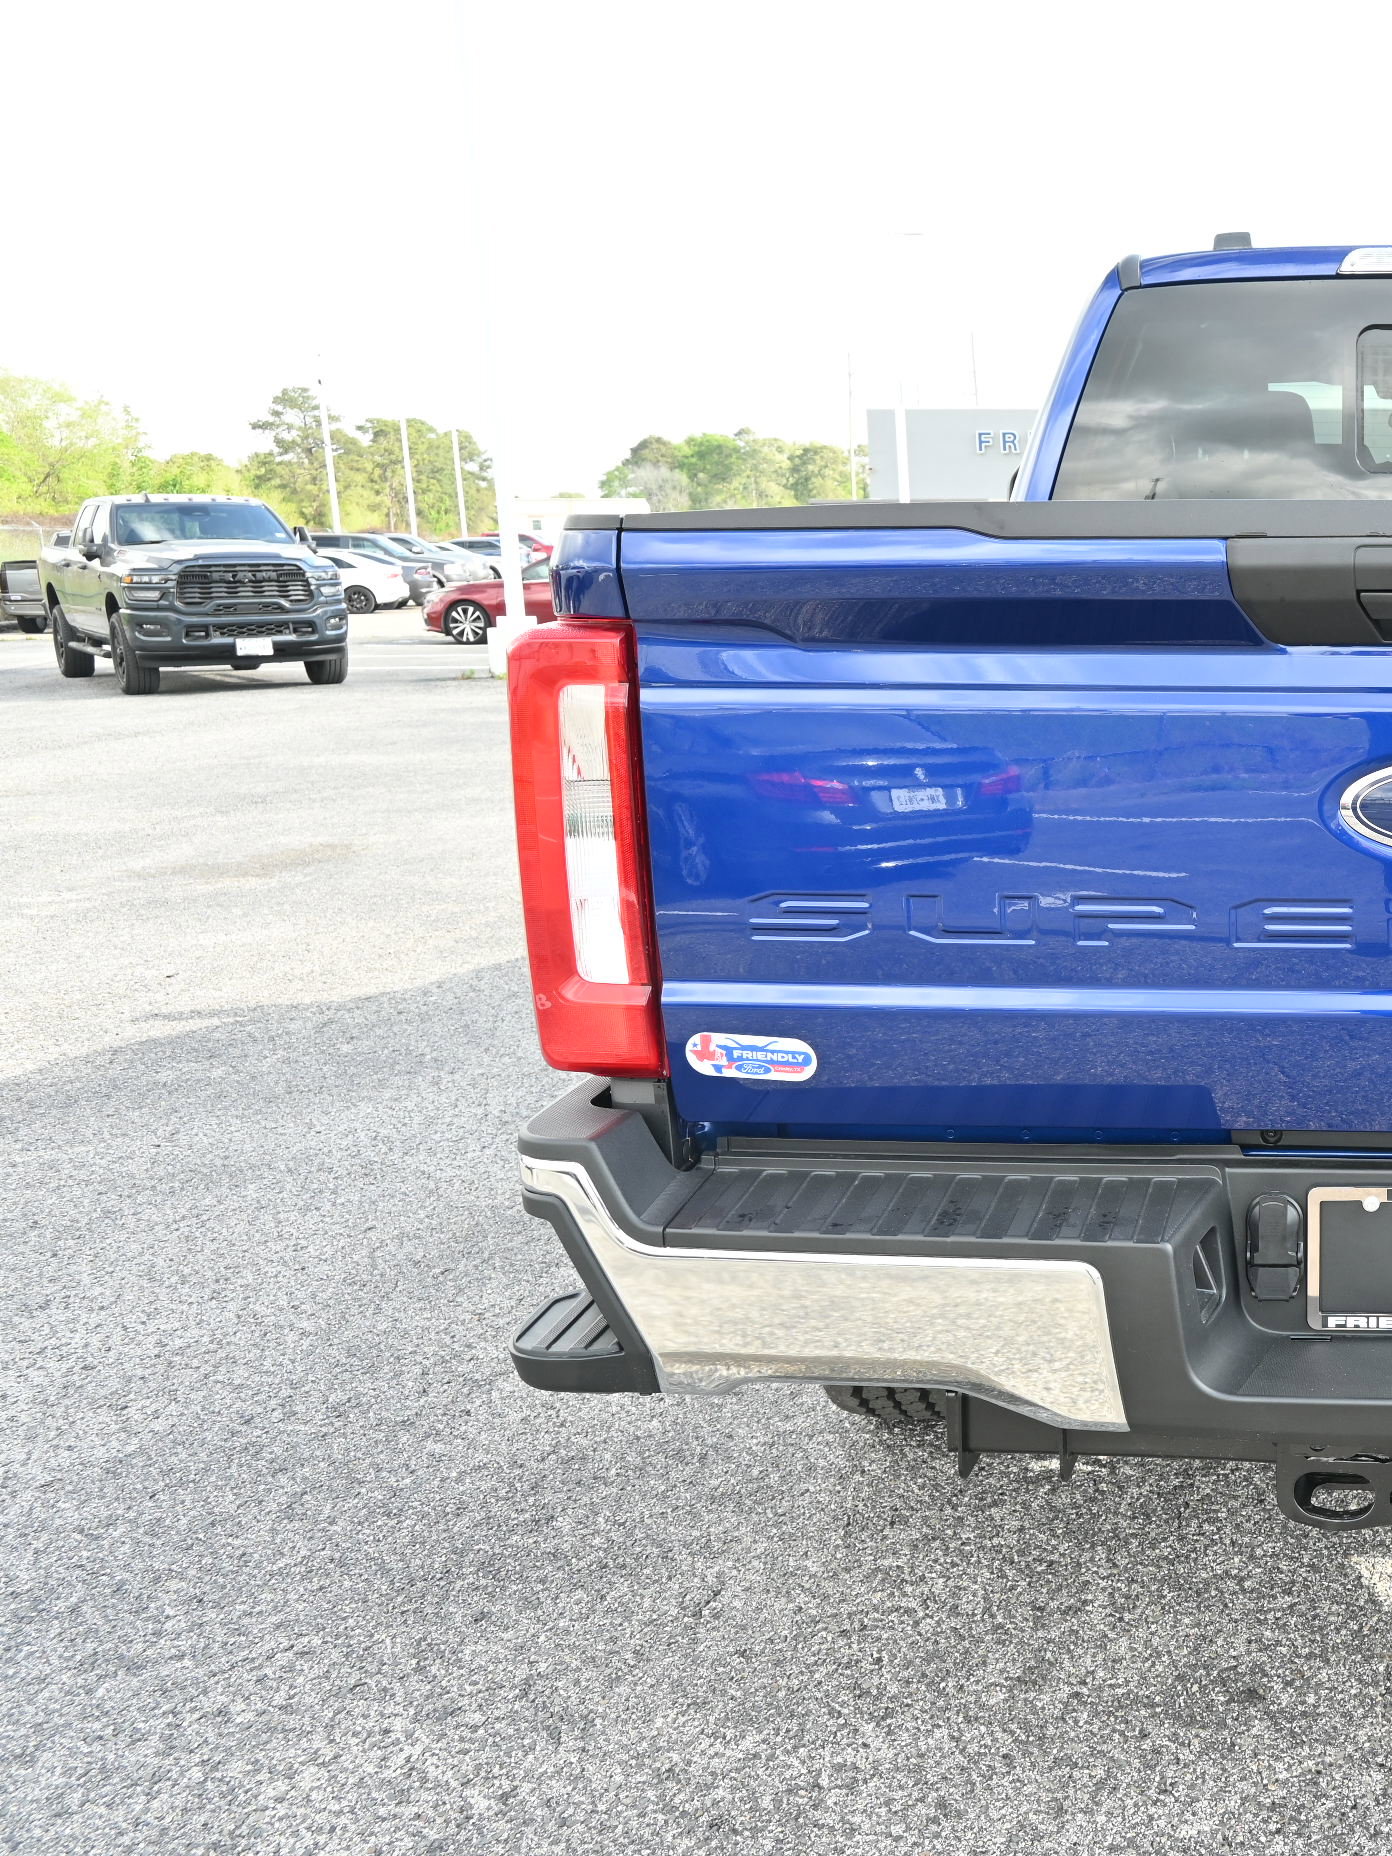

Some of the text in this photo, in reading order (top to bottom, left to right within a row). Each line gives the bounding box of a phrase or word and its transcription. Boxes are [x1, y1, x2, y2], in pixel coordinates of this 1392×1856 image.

[976, 430, 1032, 453] FR
[209, 572, 277, 581] RAM
[732, 1049, 805, 1063] FRIENDLY
[741, 1063, 766, 1074] Ford
